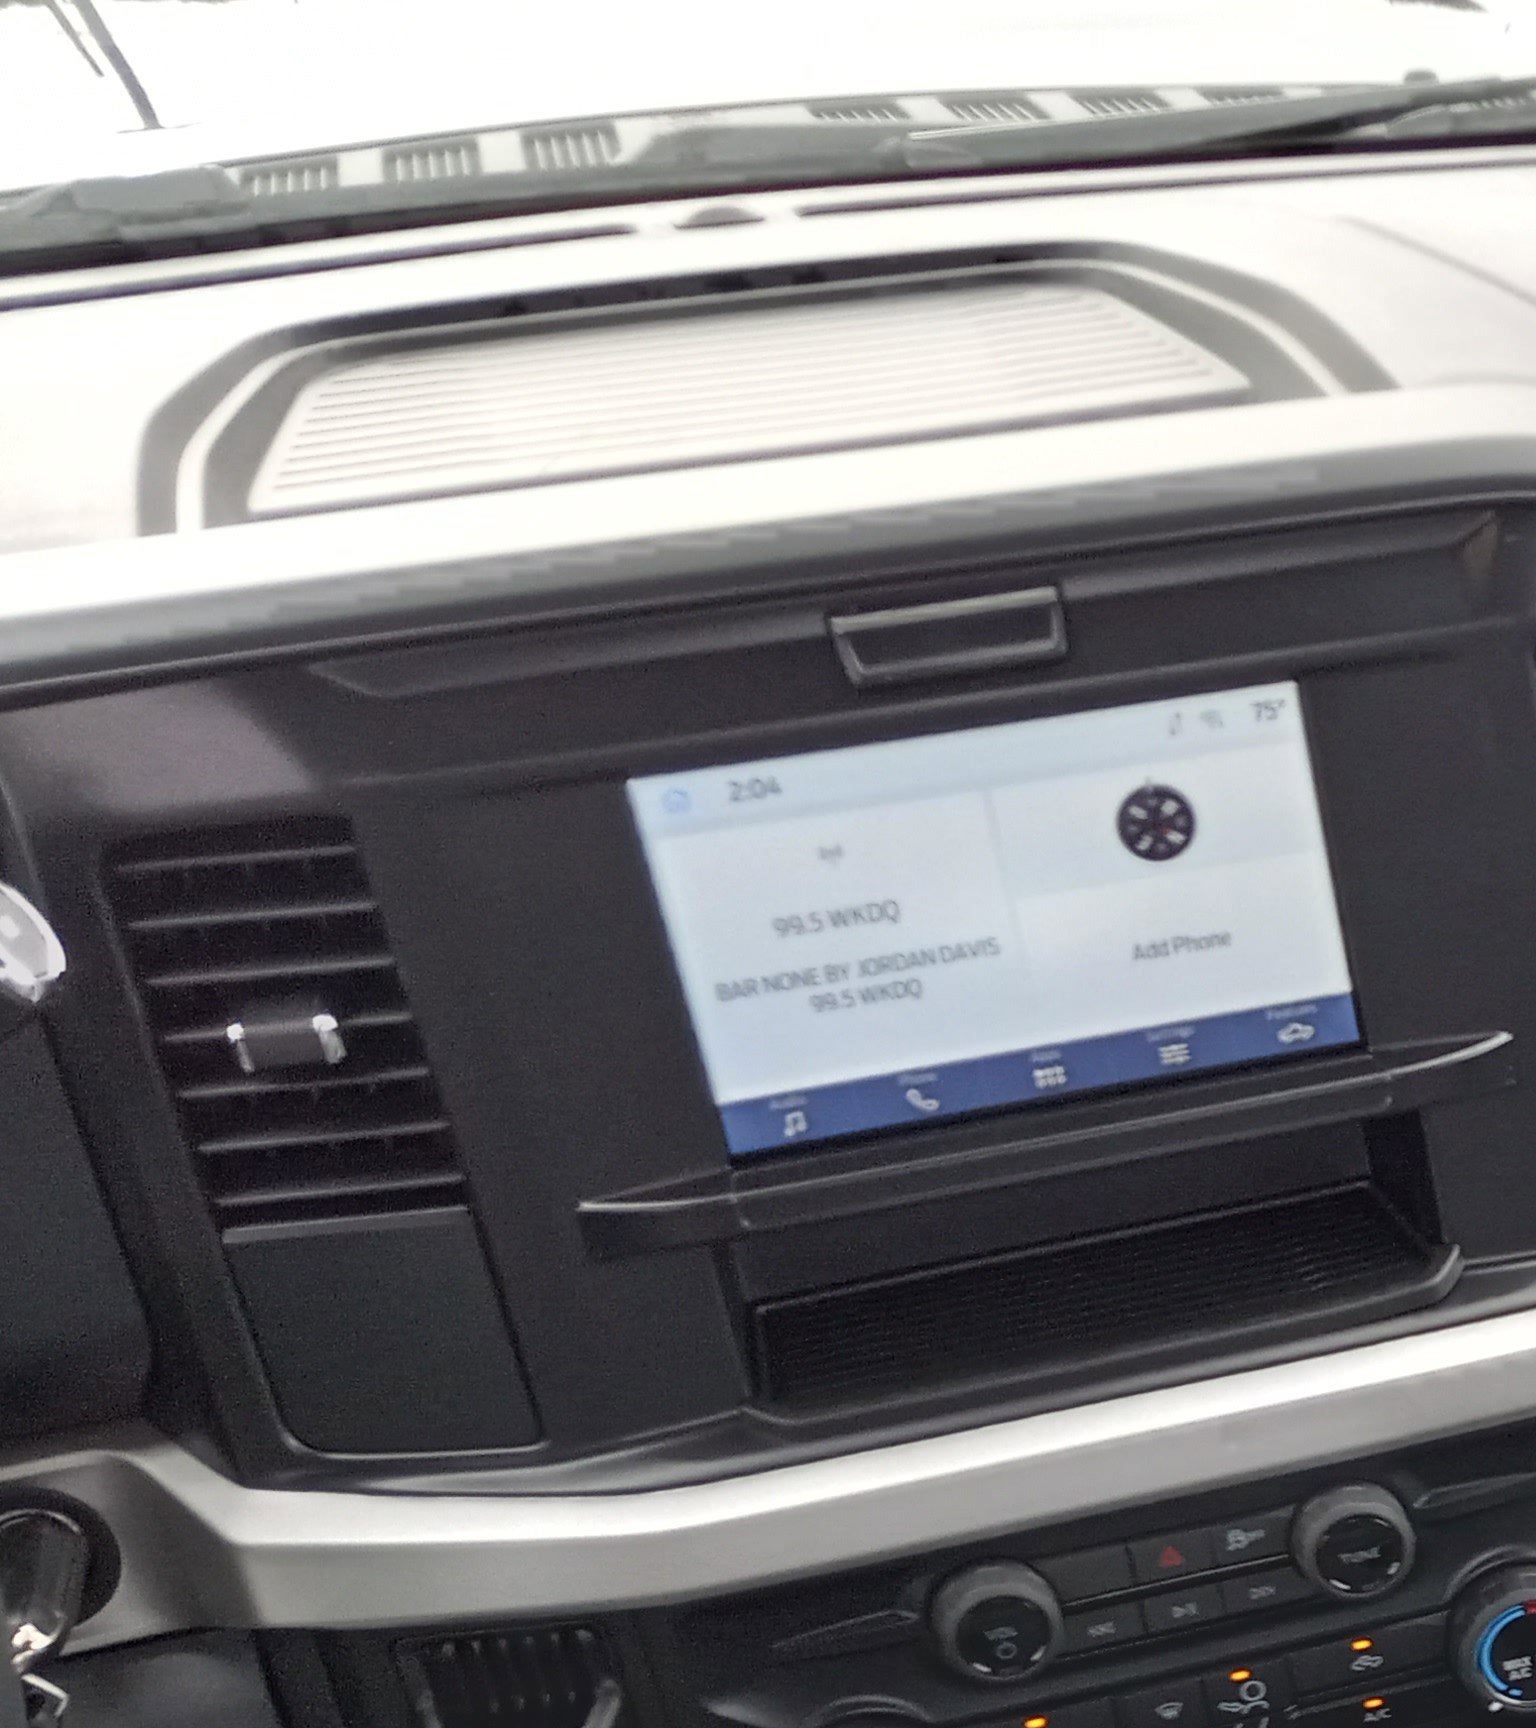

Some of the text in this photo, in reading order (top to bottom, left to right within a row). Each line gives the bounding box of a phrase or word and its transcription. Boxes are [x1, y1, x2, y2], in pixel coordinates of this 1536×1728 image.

[727, 776, 783, 802] 2:04
[771, 913, 825, 939] 99.5
[1131, 929, 1232, 961] Add Phone
